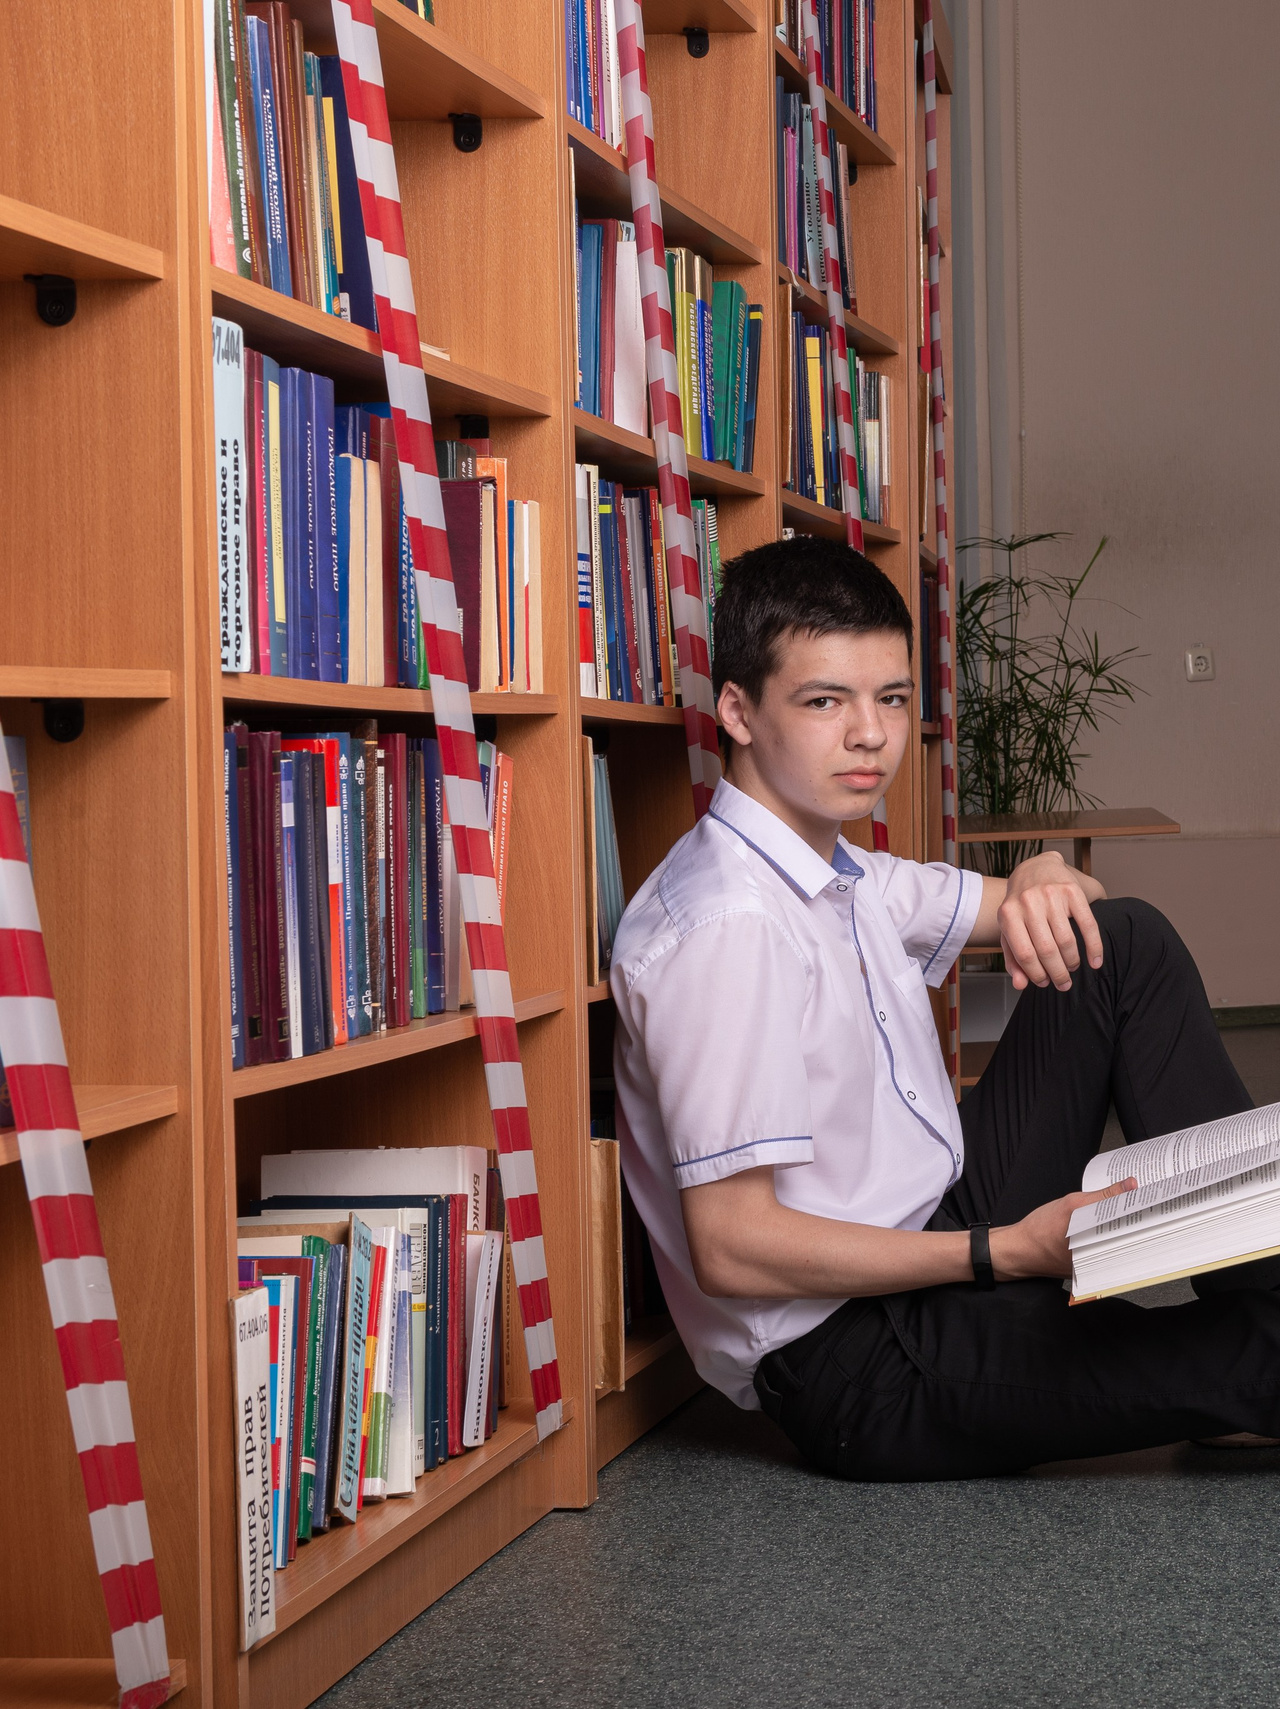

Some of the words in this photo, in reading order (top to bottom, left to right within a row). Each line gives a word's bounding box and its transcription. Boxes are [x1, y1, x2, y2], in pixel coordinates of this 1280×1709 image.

[265, 89, 278, 182] НАЛОГОВЫЙ
[272, 186, 282, 244] КОДЕКС
[804, 177, 814, 242] Уголовно-
[688, 303, 697, 360] РОССИЙСКОЙ
[702, 311, 711, 364] РОССИЙСКОЙ
[736, 302, 746, 368] СПРАВОЧНИК
[690, 364, 699, 415] ФЕДЕРАЦИИ
[222, 438, 227, 456] и
[233, 438, 241, 524] право
[328, 428, 337, 536] ГРАЖДАНСКОЕ
[219, 466, 231, 666] Гражданское
[234, 534, 243, 666] торговое
[656, 552, 664, 602] ТРУДОВЫЕ
[274, 782, 282, 848] ГРАЖДАНСКОЕ
[435, 778, 443, 882] ГРАЖДАНСКОЕ
[343, 812, 352, 920] Предпринимательское
[411, 1222, 422, 1296] ПРАВО
[239, 1314, 269, 1342] 67.404.06
[351, 1276, 370, 1358] право
[474, 1316, 489, 1440] Банковское
[487, 1238, 495, 1300] право
[245, 1396, 257, 1476] прав
[339, 1364, 364, 1508] Страховое
[435, 1428, 440, 1445] 2
[258, 1384, 273, 1618] потребителей
[248, 1498, 258, 1628] Защита
